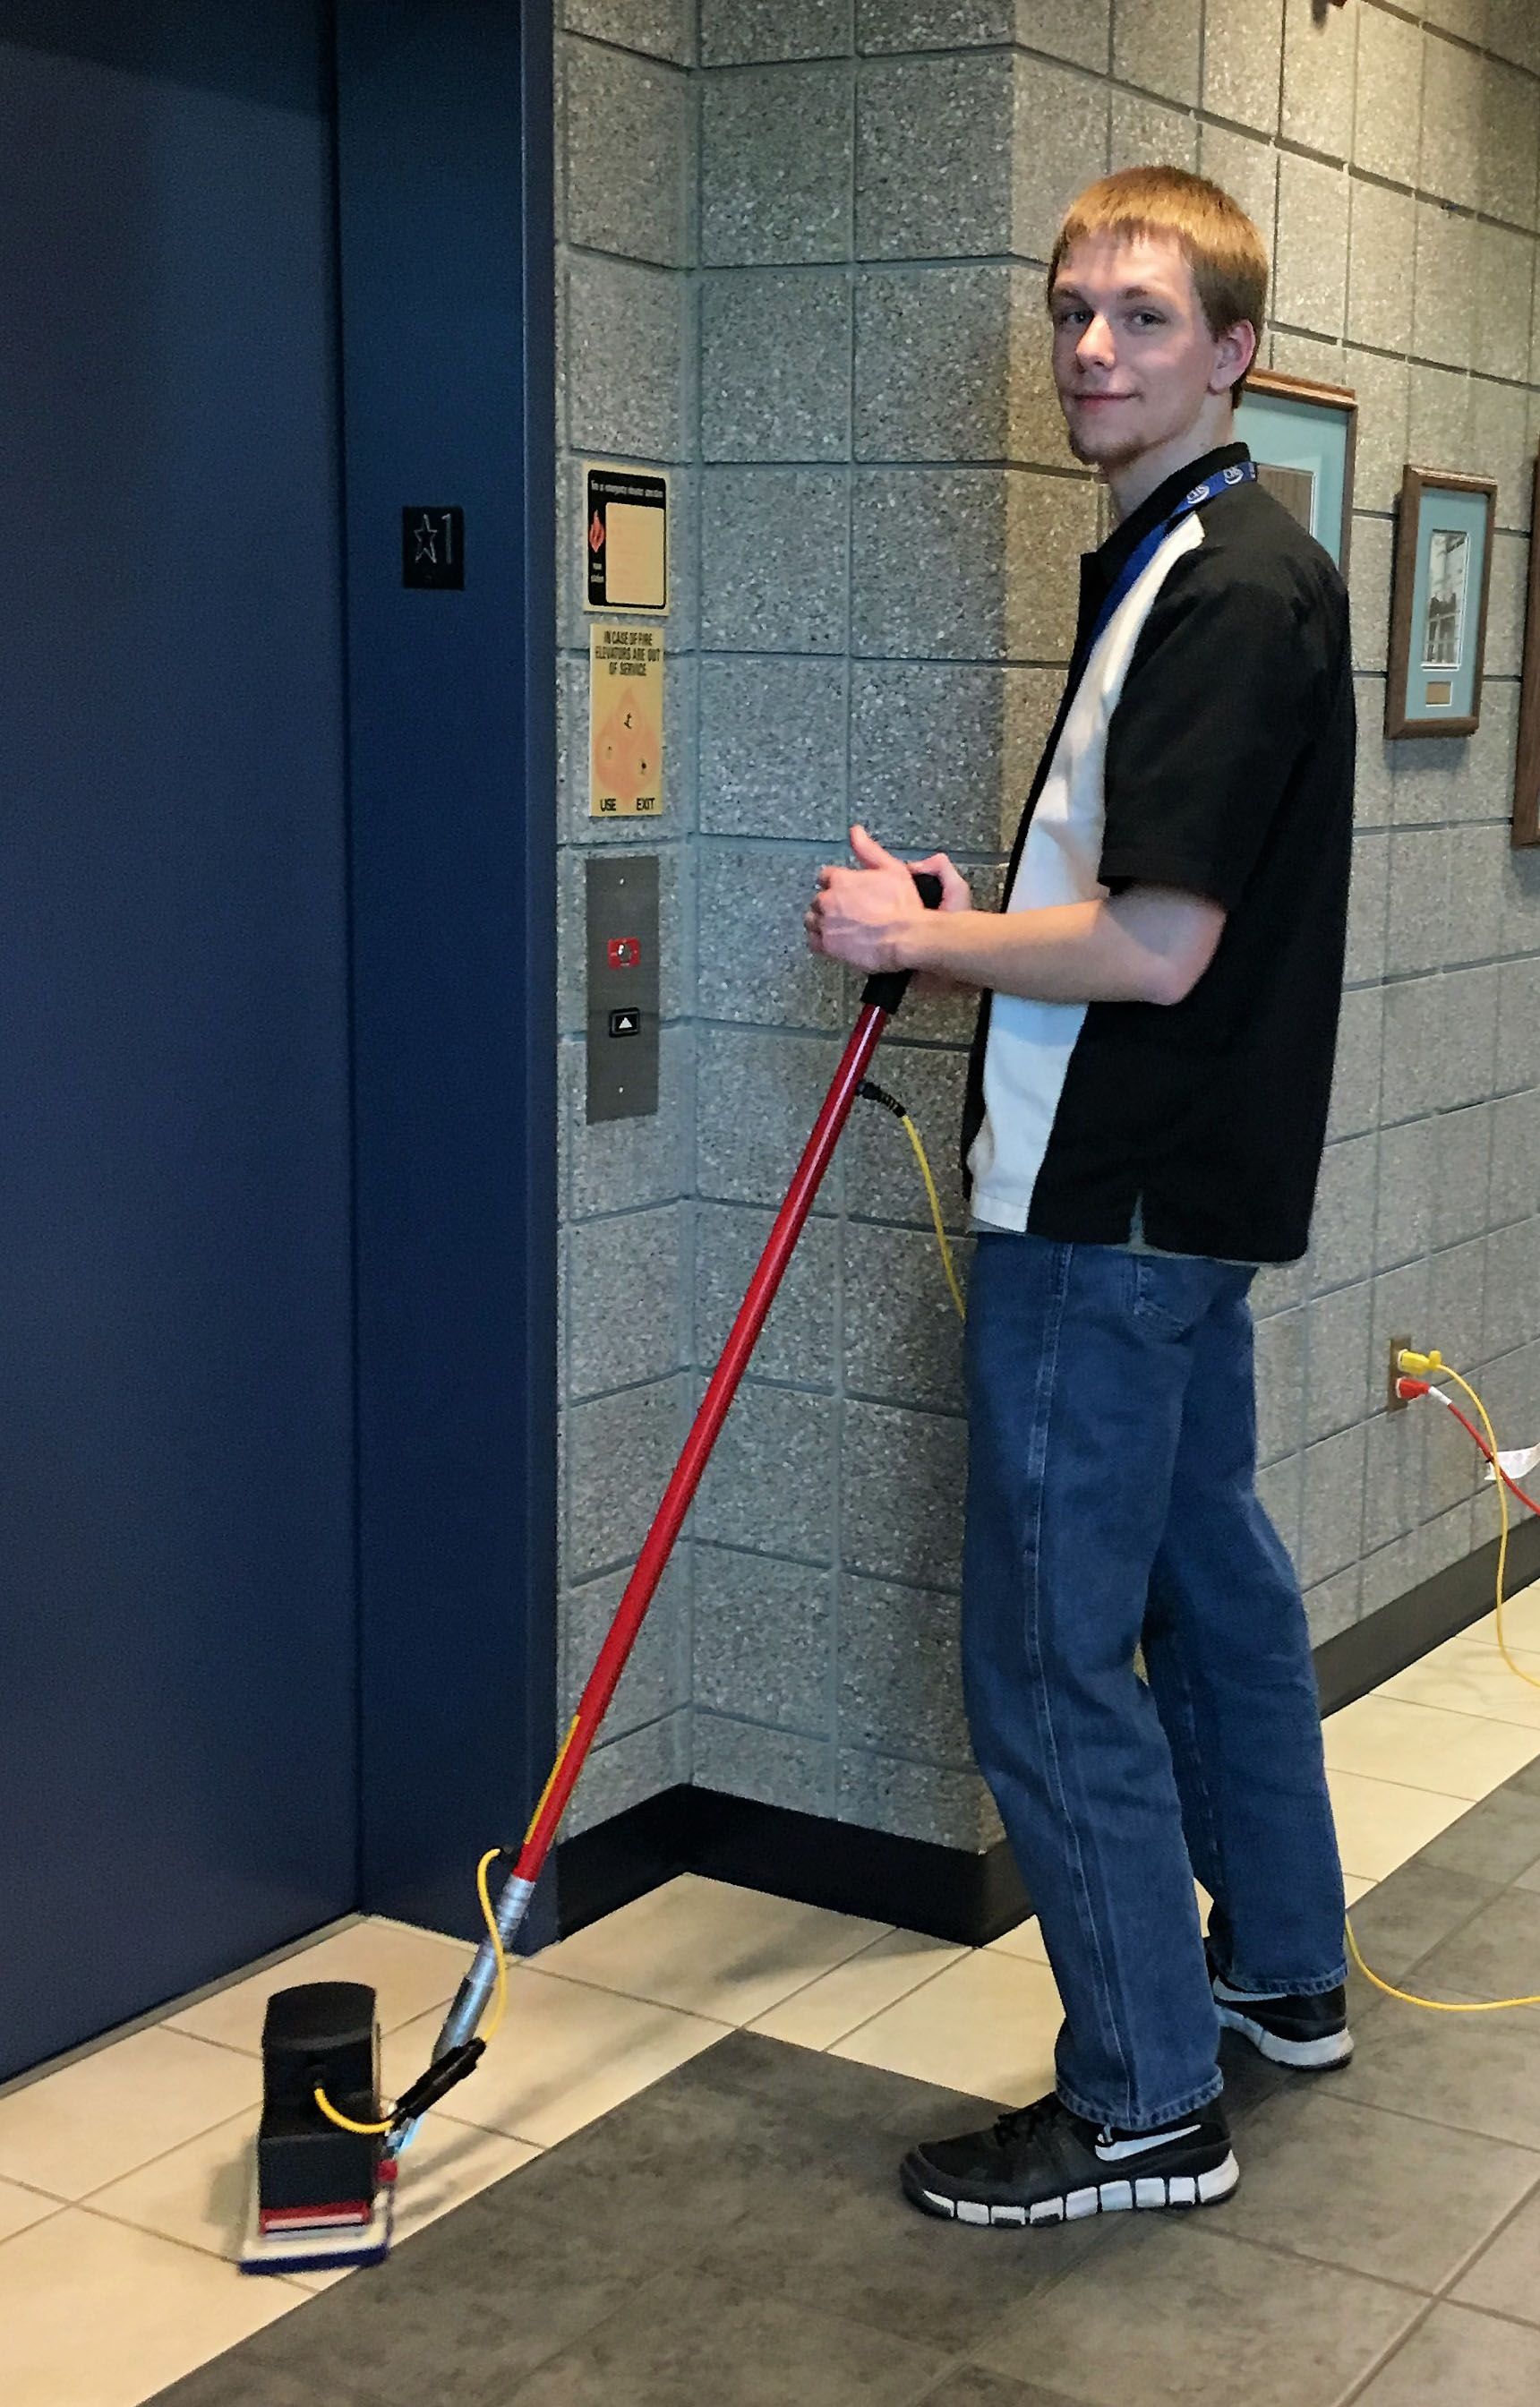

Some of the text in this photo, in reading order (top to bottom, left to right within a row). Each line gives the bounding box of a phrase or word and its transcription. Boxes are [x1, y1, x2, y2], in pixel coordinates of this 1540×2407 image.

[441, 513, 451, 564] 1
[603, 630, 652, 646] IN CASE OF FIRE
[595, 646, 660, 662] ELEVATORS ARE OUT
[609, 662, 646, 676] OF SERVICE
[600, 797, 655, 811] USE EXIT
